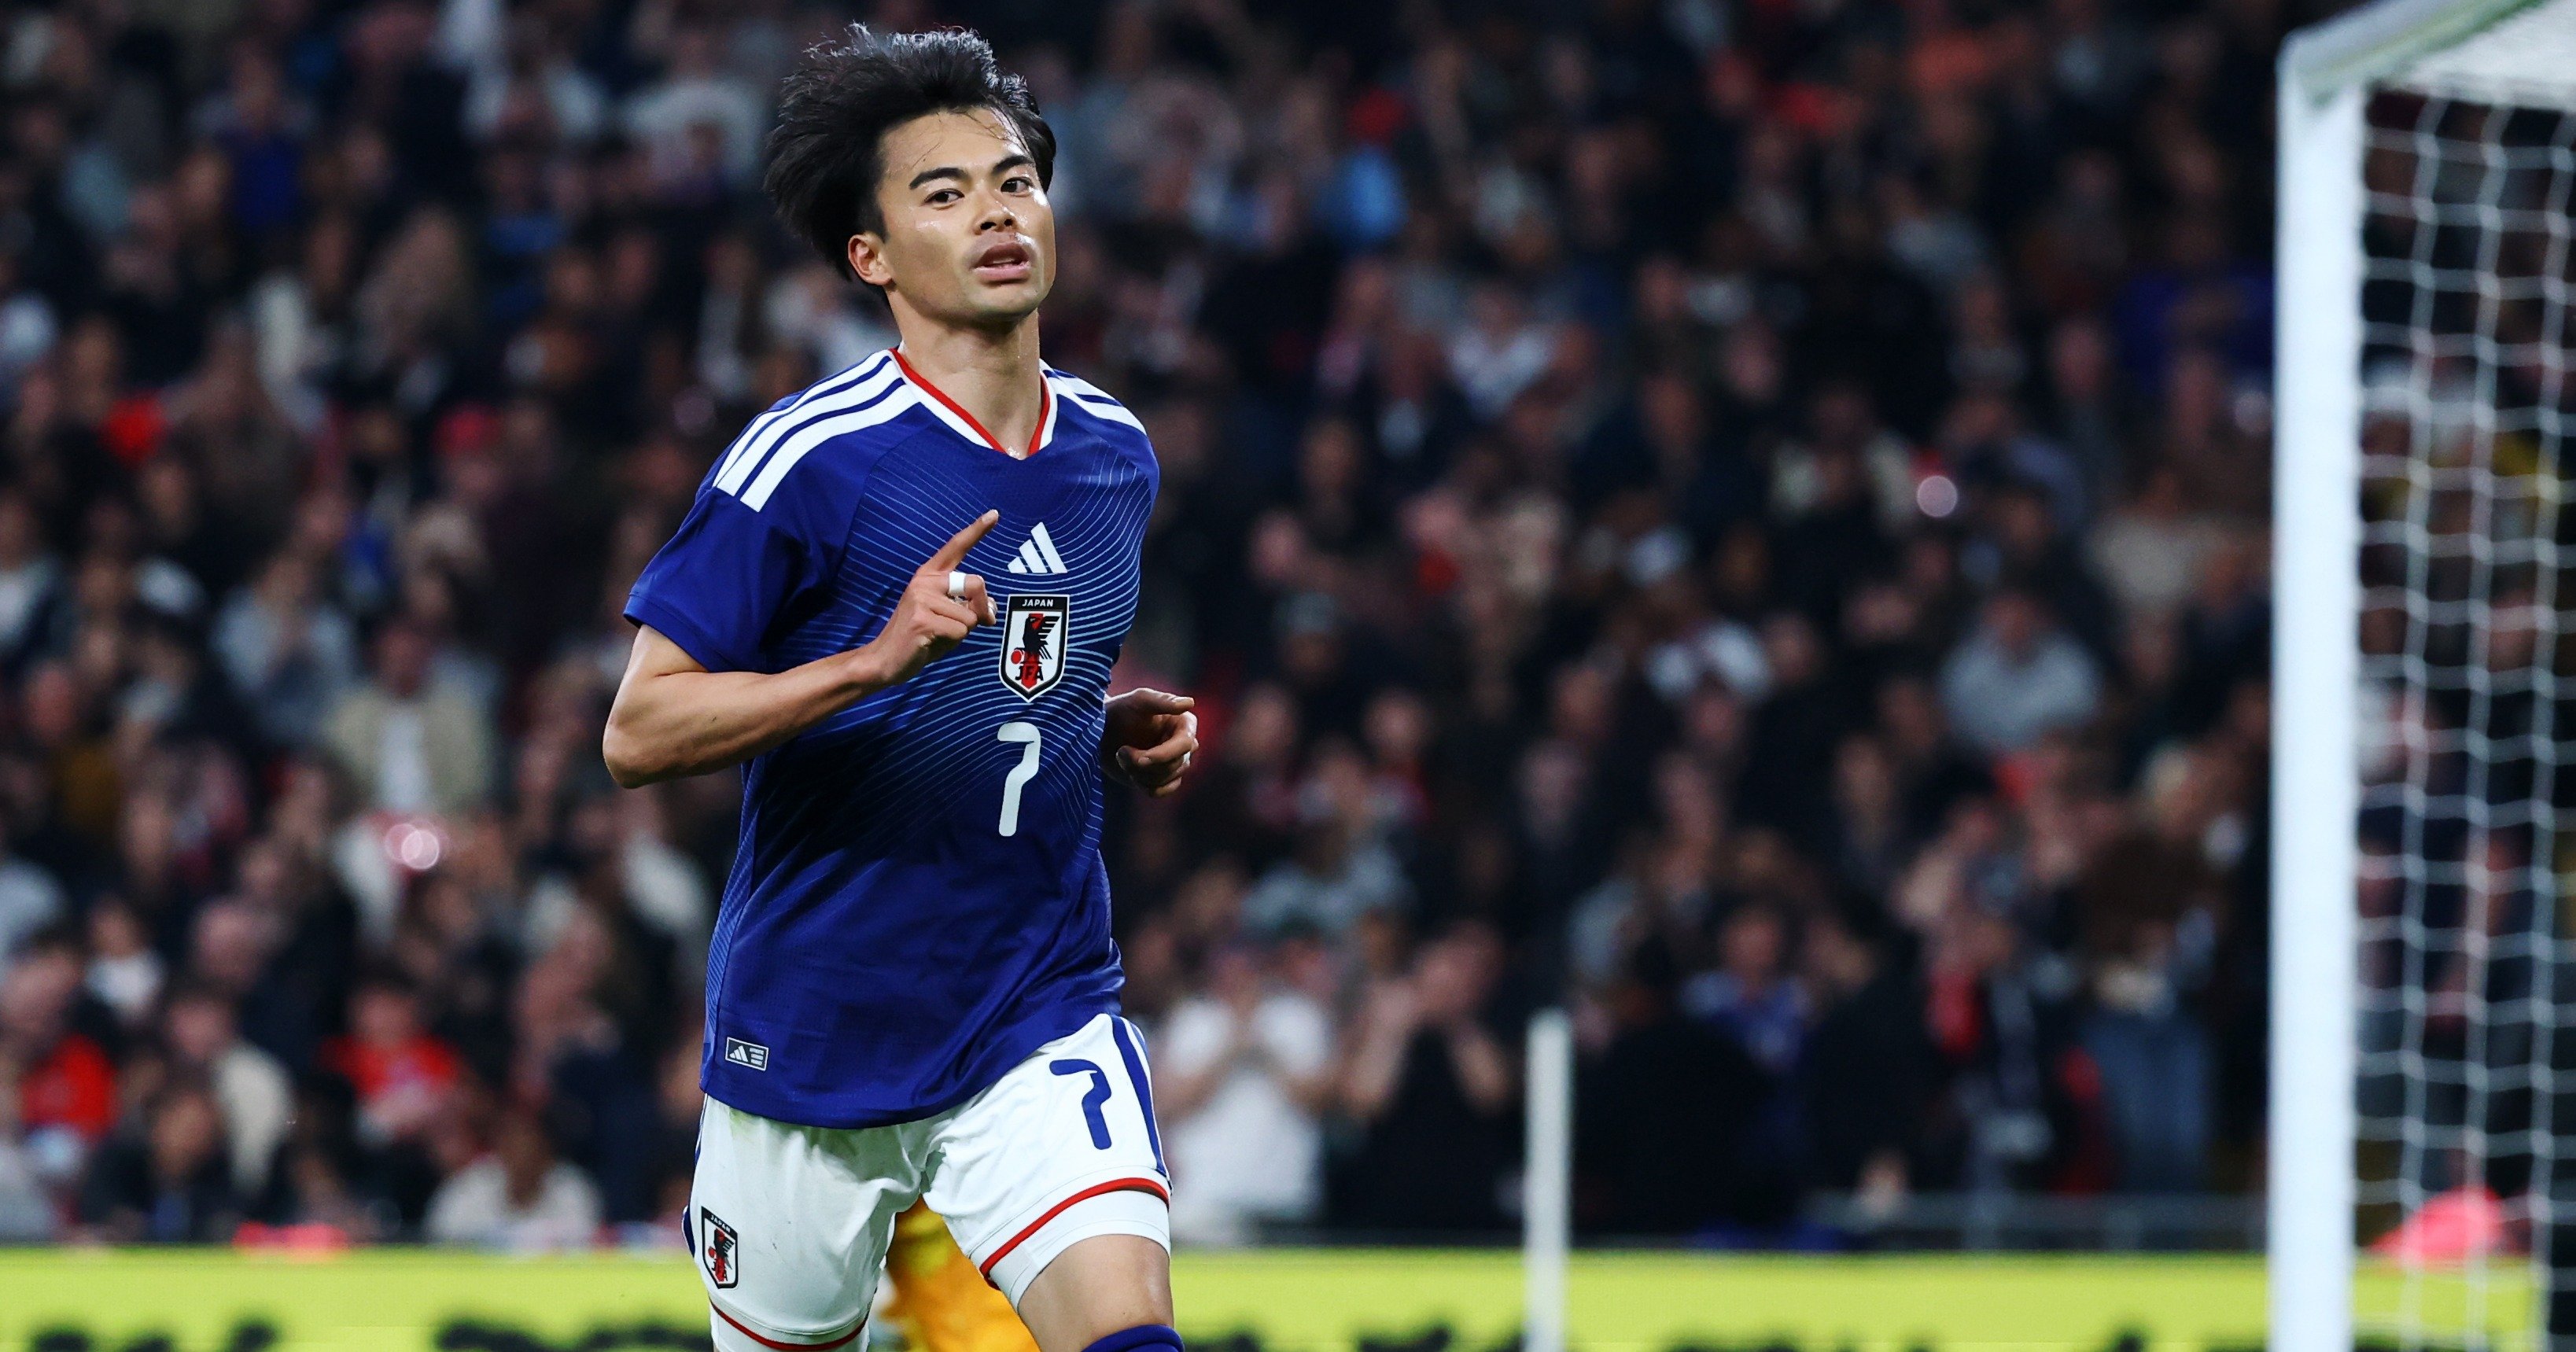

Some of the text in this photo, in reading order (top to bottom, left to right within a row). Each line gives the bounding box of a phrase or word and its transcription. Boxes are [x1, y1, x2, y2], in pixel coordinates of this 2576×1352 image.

[1022, 599, 1054, 607] JAPAN
[1015, 665, 1044, 681] JFA
[997, 721, 1041, 837] 7
[1049, 1059, 1112, 1150] 7
[710, 1214, 731, 1233] JAPAN
